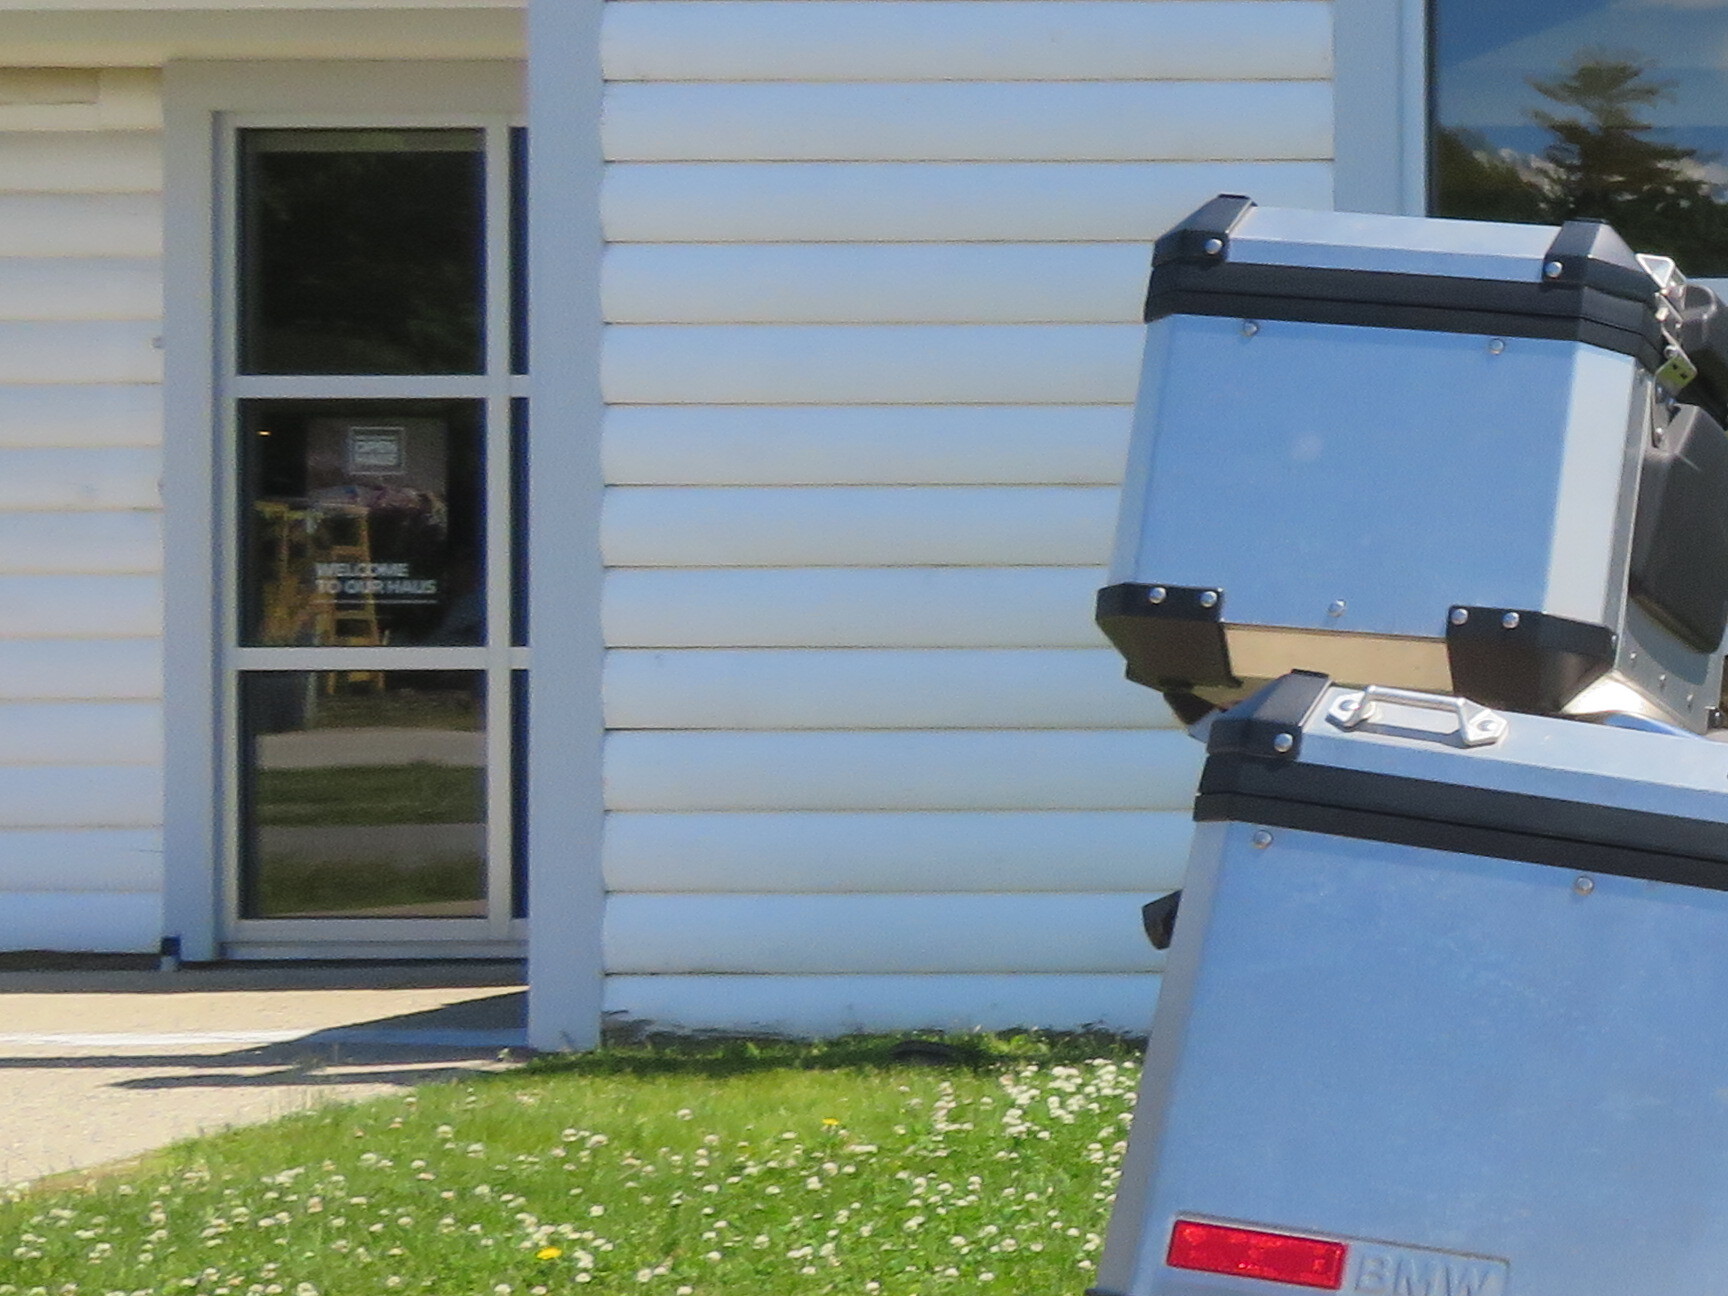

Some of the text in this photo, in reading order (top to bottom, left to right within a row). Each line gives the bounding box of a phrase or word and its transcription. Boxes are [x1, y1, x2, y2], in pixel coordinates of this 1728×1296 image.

[316, 563, 409, 578] WELCOME
[316, 579, 438, 594] TO OUR HAUS
